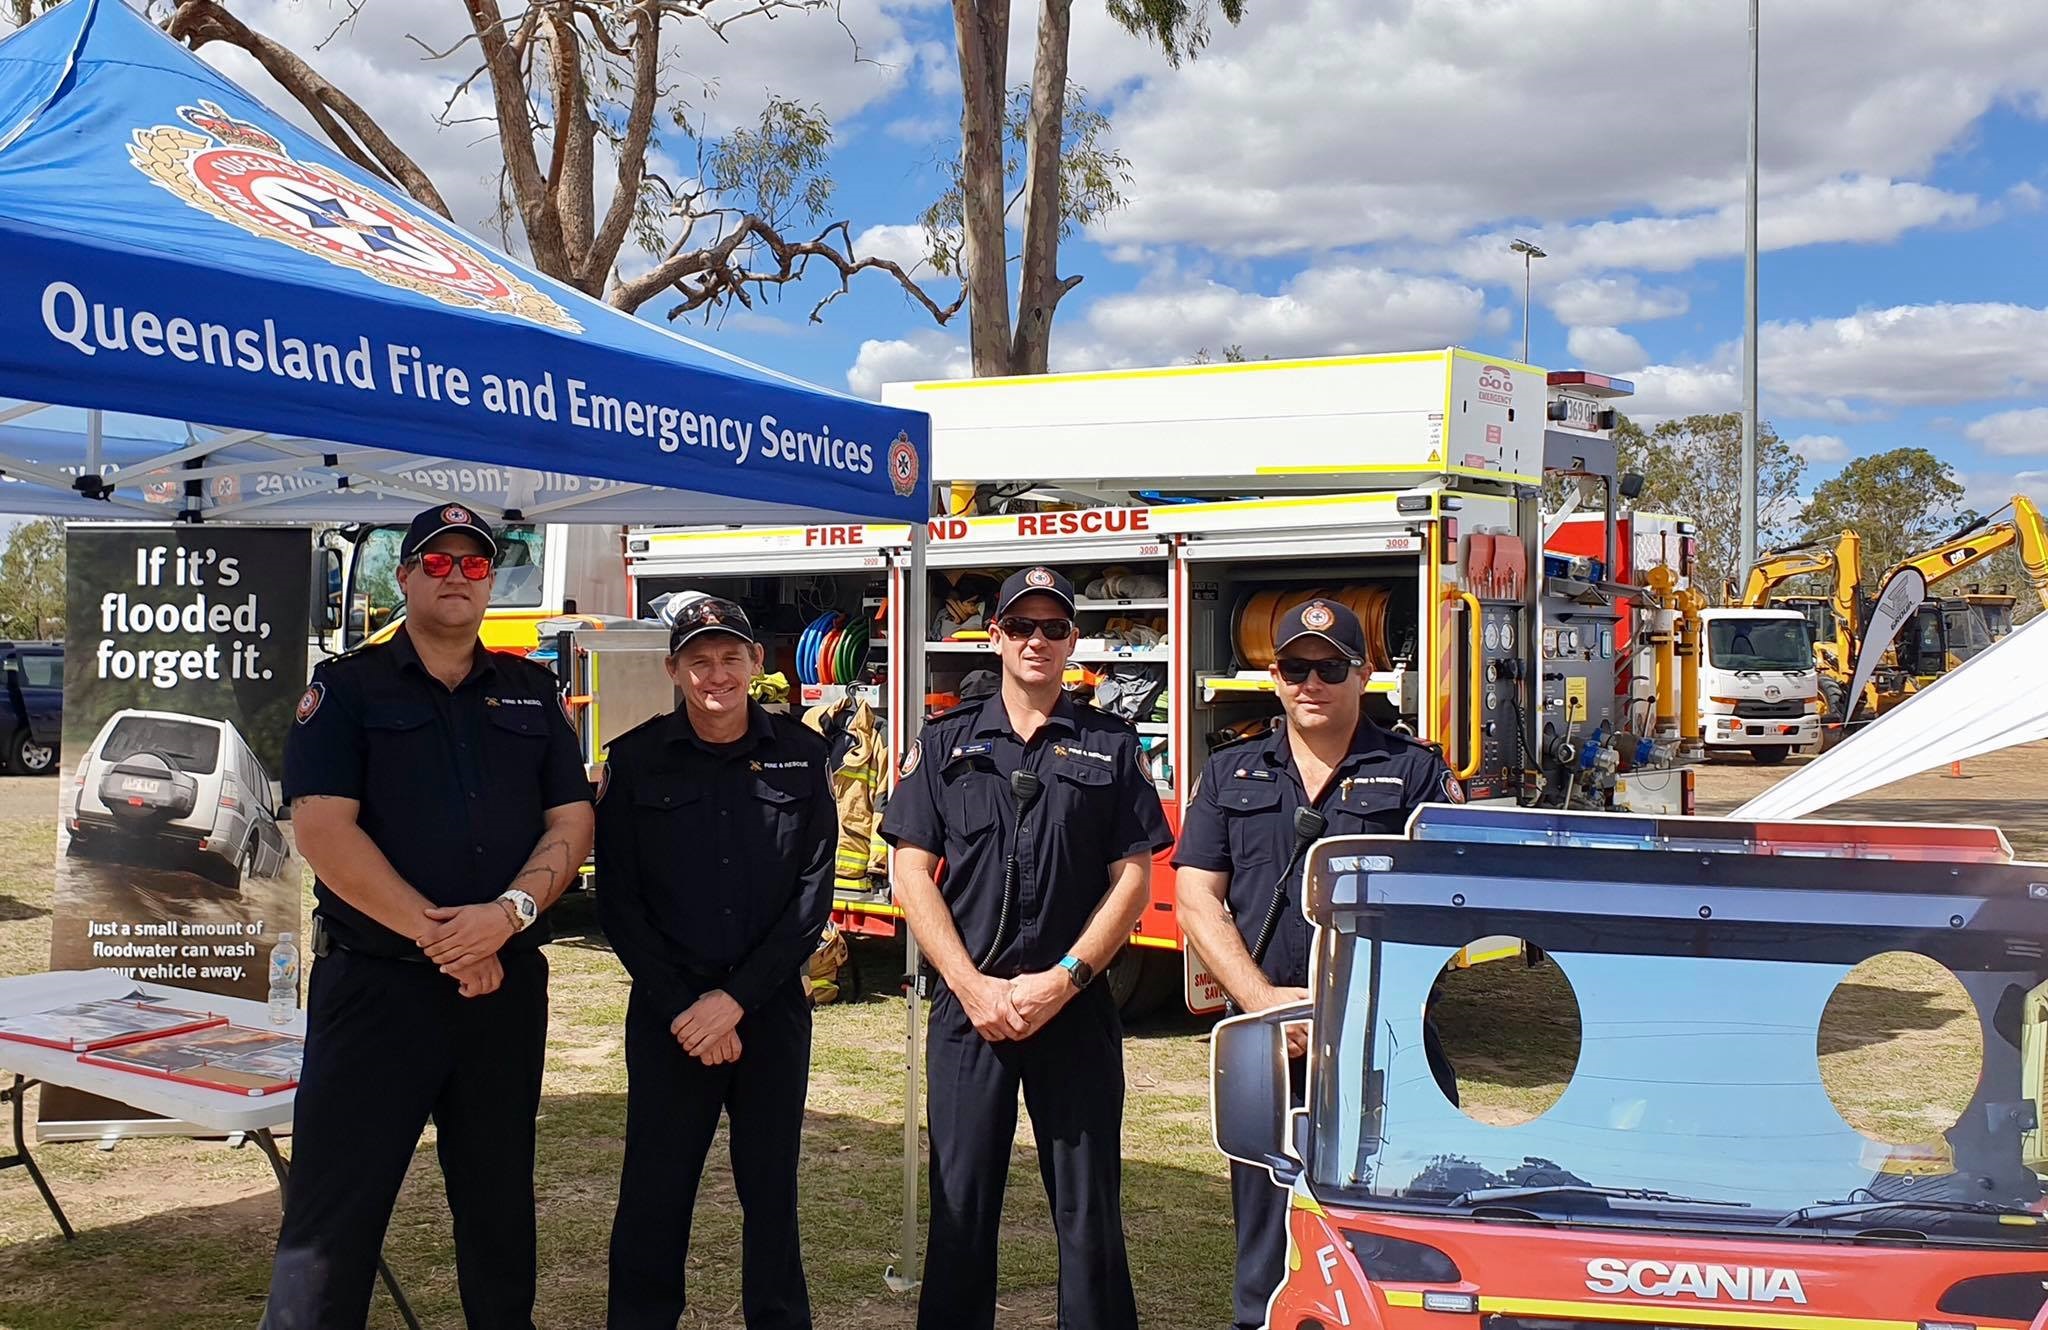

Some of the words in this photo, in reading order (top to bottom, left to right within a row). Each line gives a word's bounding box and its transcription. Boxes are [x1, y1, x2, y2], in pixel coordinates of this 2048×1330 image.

[210, 156, 378, 212] QUEENSLAND
[41, 281, 378, 391] Queensland
[387, 343, 471, 406] Fire
[481, 371, 557, 422] and
[567, 378, 752, 464] Emergency
[760, 415, 873, 474] Services
[1478, 391, 1512, 406] EMERGENCY
[806, 525, 863, 546] FIRE
[1018, 509, 1150, 537] RESCUE
[1385, 538, 1409, 548] 3000
[137, 546, 167, 586] If
[101, 593, 271, 640] flooded,
[97, 639, 220, 689] forget
[232, 640, 273, 680] it.
[88, 920, 117, 938] Just
[121, 924, 131, 935] a
[135, 921, 178, 936] small
[181, 922, 242, 936] amount
[246, 920, 263, 935] of
[93, 942, 177, 958] floodwater
[181, 944, 209, 957] can
[213, 941, 255, 957] wash
[139, 964, 196, 979] vehicle
[200, 966, 246, 981] away.
[1585, 1257, 1808, 1304] SCANIA
